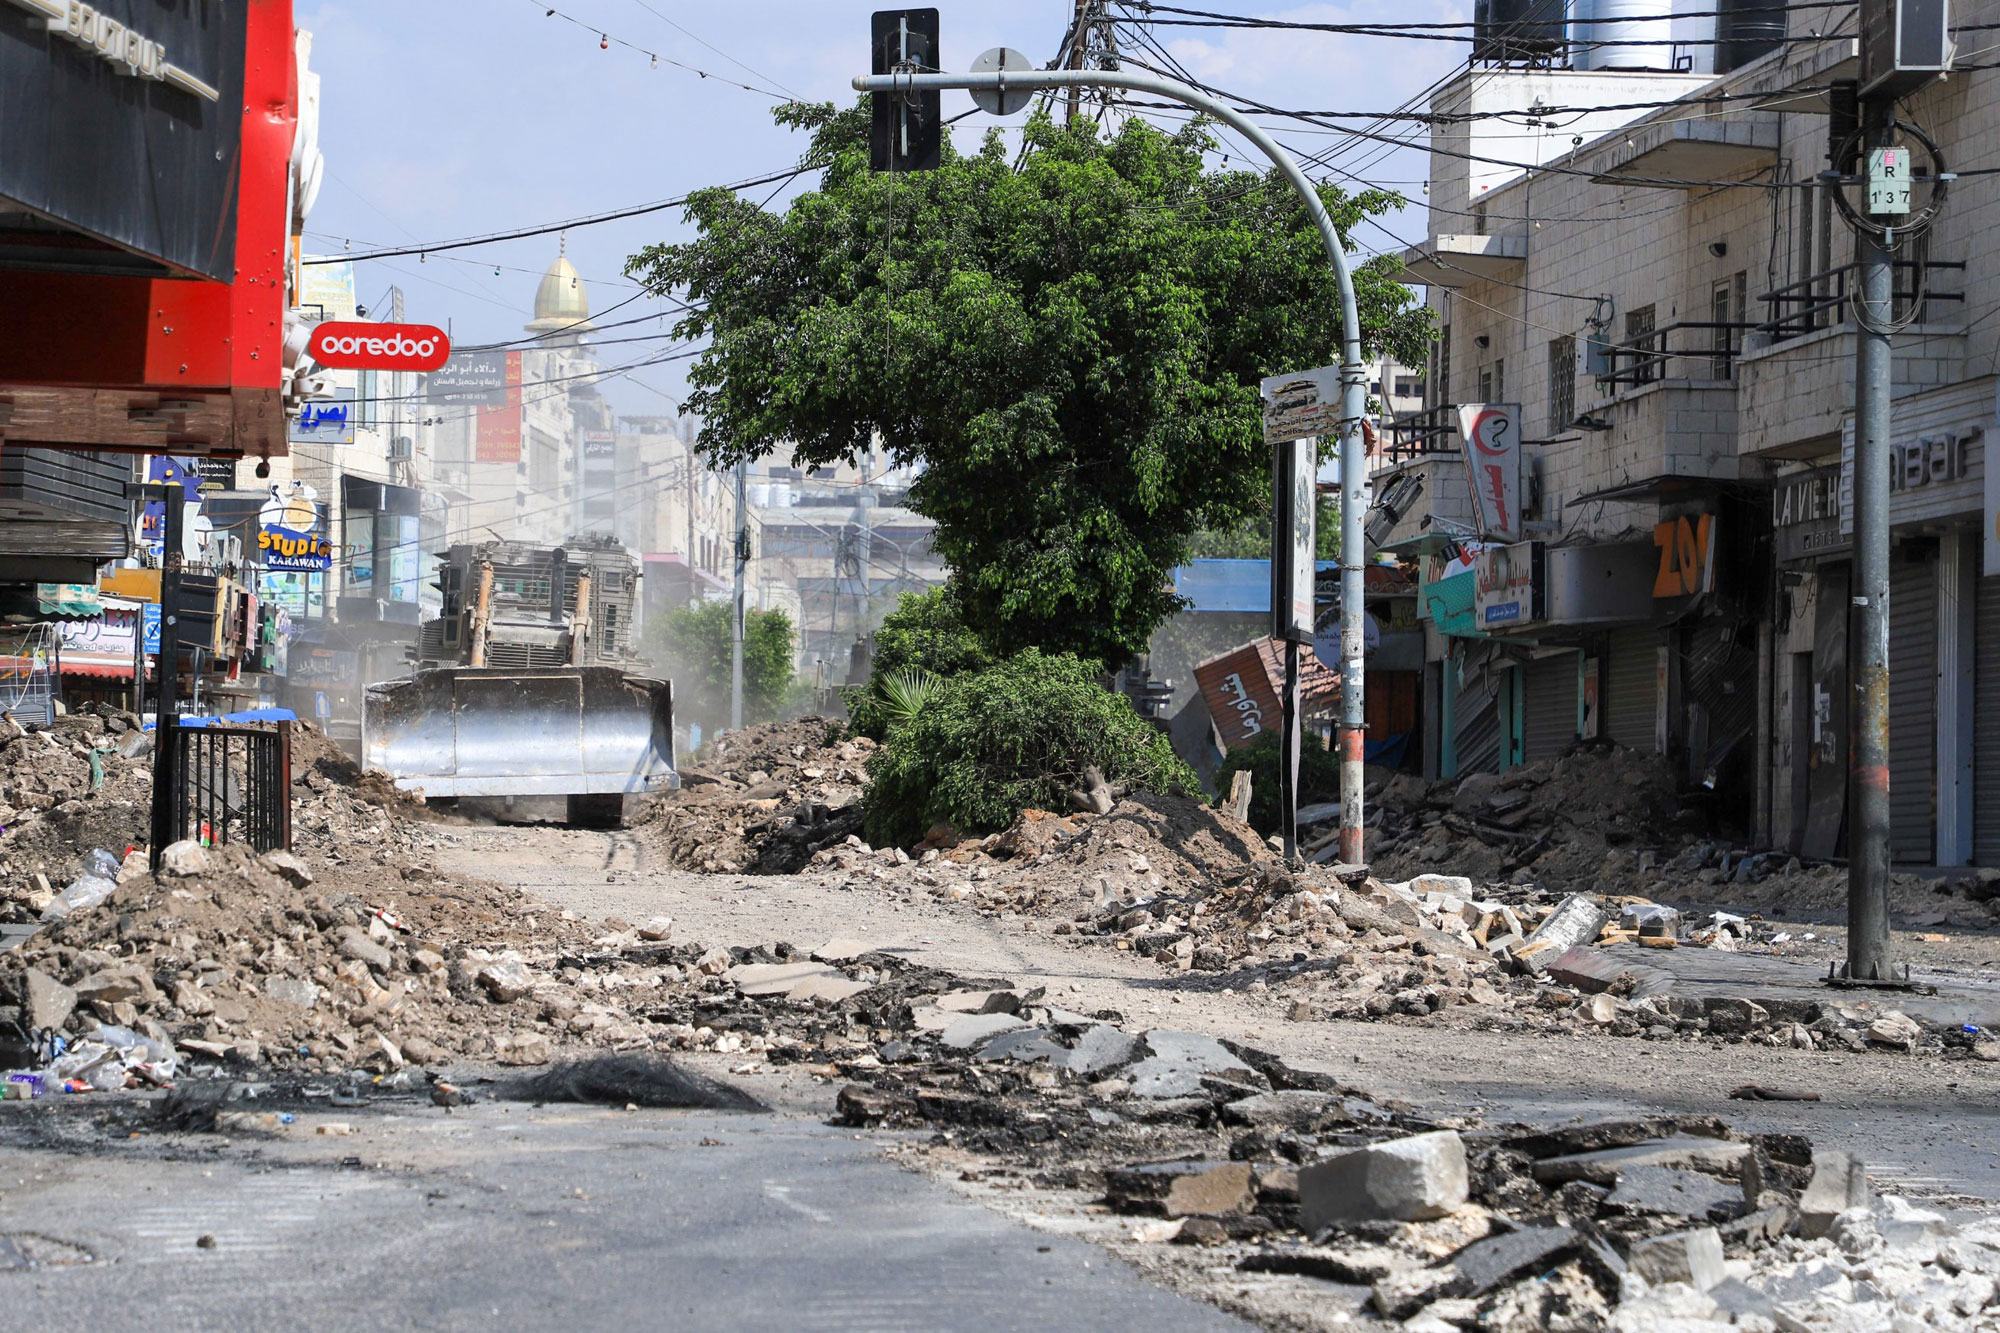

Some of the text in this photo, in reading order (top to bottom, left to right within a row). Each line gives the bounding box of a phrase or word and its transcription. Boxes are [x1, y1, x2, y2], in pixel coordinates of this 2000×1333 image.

[1885, 166, 1895, 178] R
[321, 333, 440, 358] ooredoo
[1773, 475, 1841, 528] LA VIE H
[268, 555, 323, 568] KARAWAN
[1219, 672, 1263, 740] شاورما
